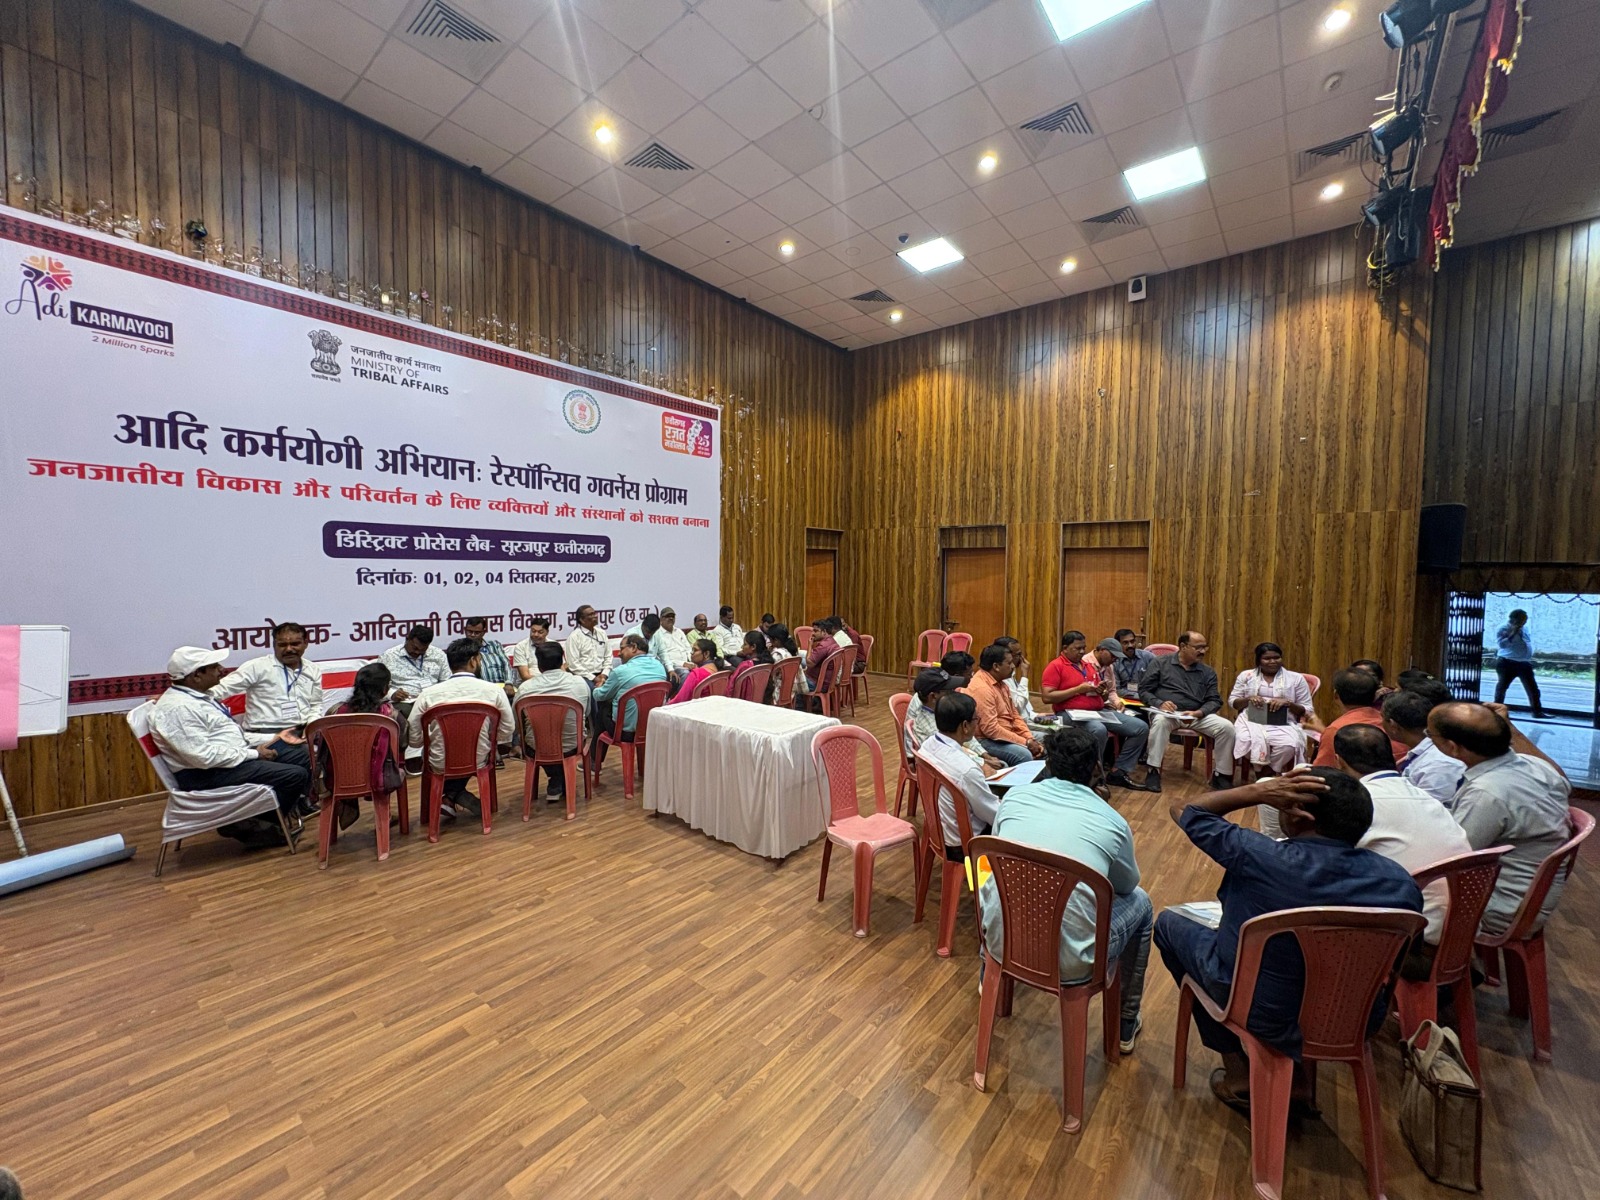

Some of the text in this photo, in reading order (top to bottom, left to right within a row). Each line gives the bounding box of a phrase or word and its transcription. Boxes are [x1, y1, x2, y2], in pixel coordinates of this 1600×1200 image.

[5, 279, 170, 340] Adi KARMAYOGI
[101, 337, 137, 351] Million
[140, 344, 175, 357] Sparks
[350, 345, 442, 373] जनजातीय कार्य मंत्रालय
[351, 356, 420, 378] MINISTRY OF
[351, 366, 449, 395] TRIBAL AFFAIRS
[697, 435, 710, 448] 25
[114, 410, 209, 455] आदि
[221, 426, 363, 471] कर्मयोगी
[490, 455, 581, 495] रेस्पॉन्सिव
[645, 478, 688, 506] प्रोग्राम
[27, 458, 709, 528] जनजातीय विकास और परिवर्तन के लिए व्यक्तियों और संस्थानों को सशक्त बनाना
[336, 527, 606, 558] डिस्ट्रिक्ट प्रोसेस लैब- सूरजपुर छत्तीसगढ़
[424, 571, 448, 587] 01,
[454, 571, 479, 587] 02,
[485, 572, 504, 585] 04
[509, 569, 561, 586] सितम्बर,
[566, 572, 595, 584] 2025
[212, 618, 341, 650] आयोक-
[447, 610, 504, 635] विास
[509, 608, 563, 631] विभग,
